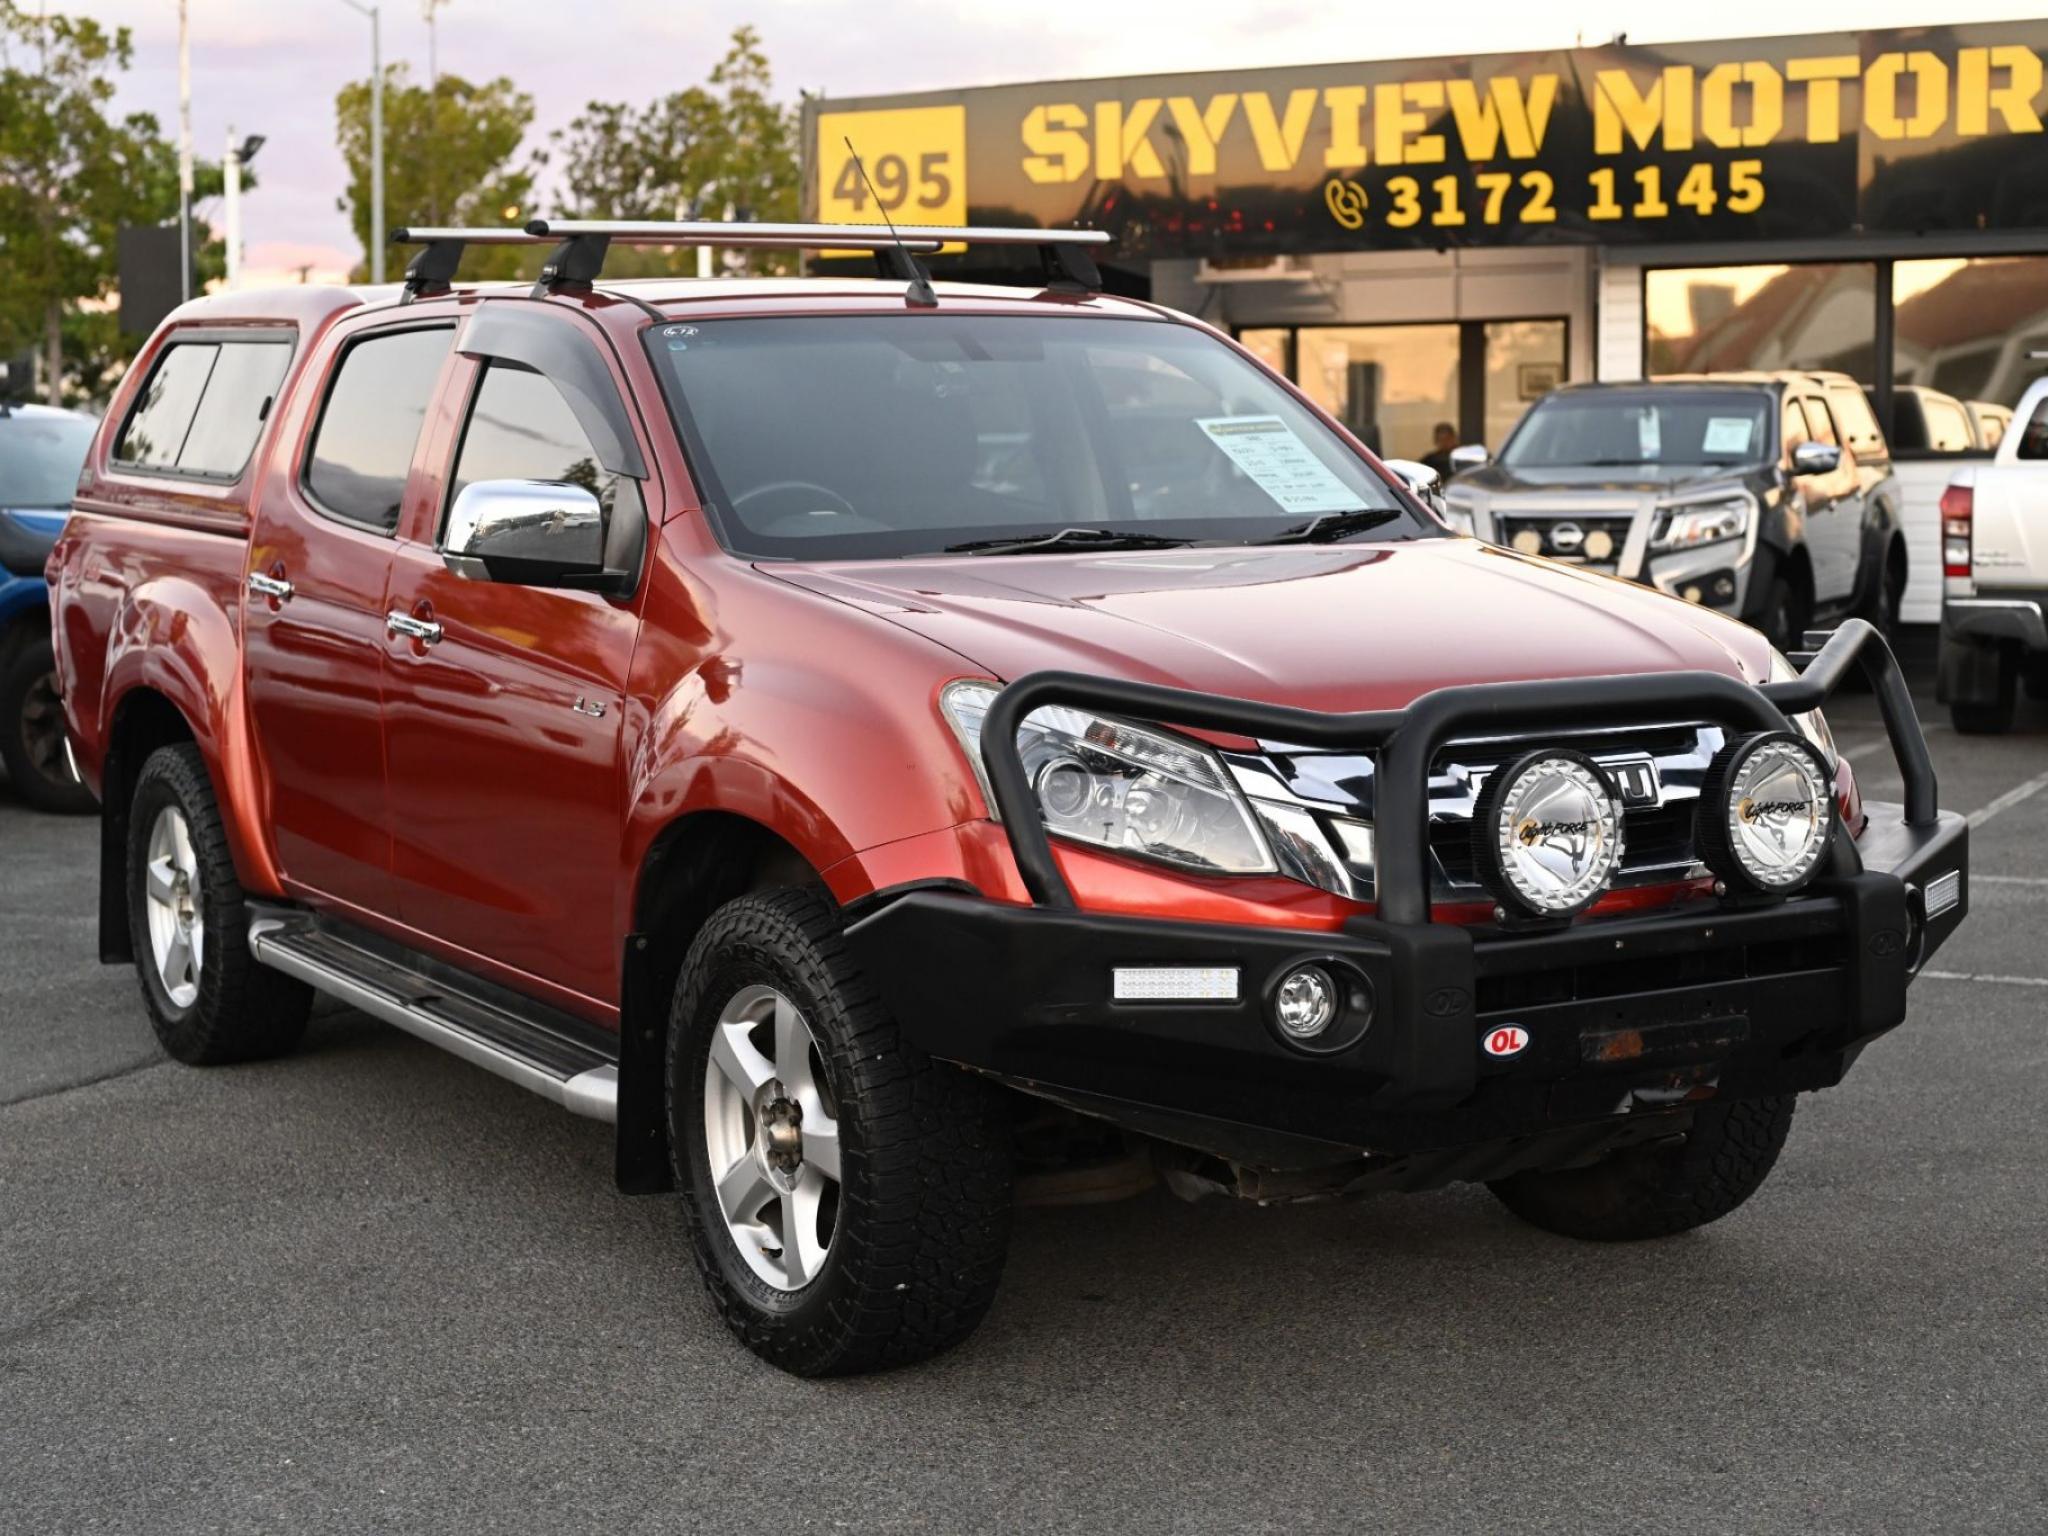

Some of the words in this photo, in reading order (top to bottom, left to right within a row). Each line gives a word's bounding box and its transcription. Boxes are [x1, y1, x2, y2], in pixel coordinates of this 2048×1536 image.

[1021, 74, 1559, 184] SKYVIEW
[1594, 45, 2044, 155] MOTOR
[832, 152, 952, 213] 495
[1386, 170, 1556, 229] 3172
[1588, 159, 1765, 221] 1145
[1491, 1029, 1521, 1053] OL
